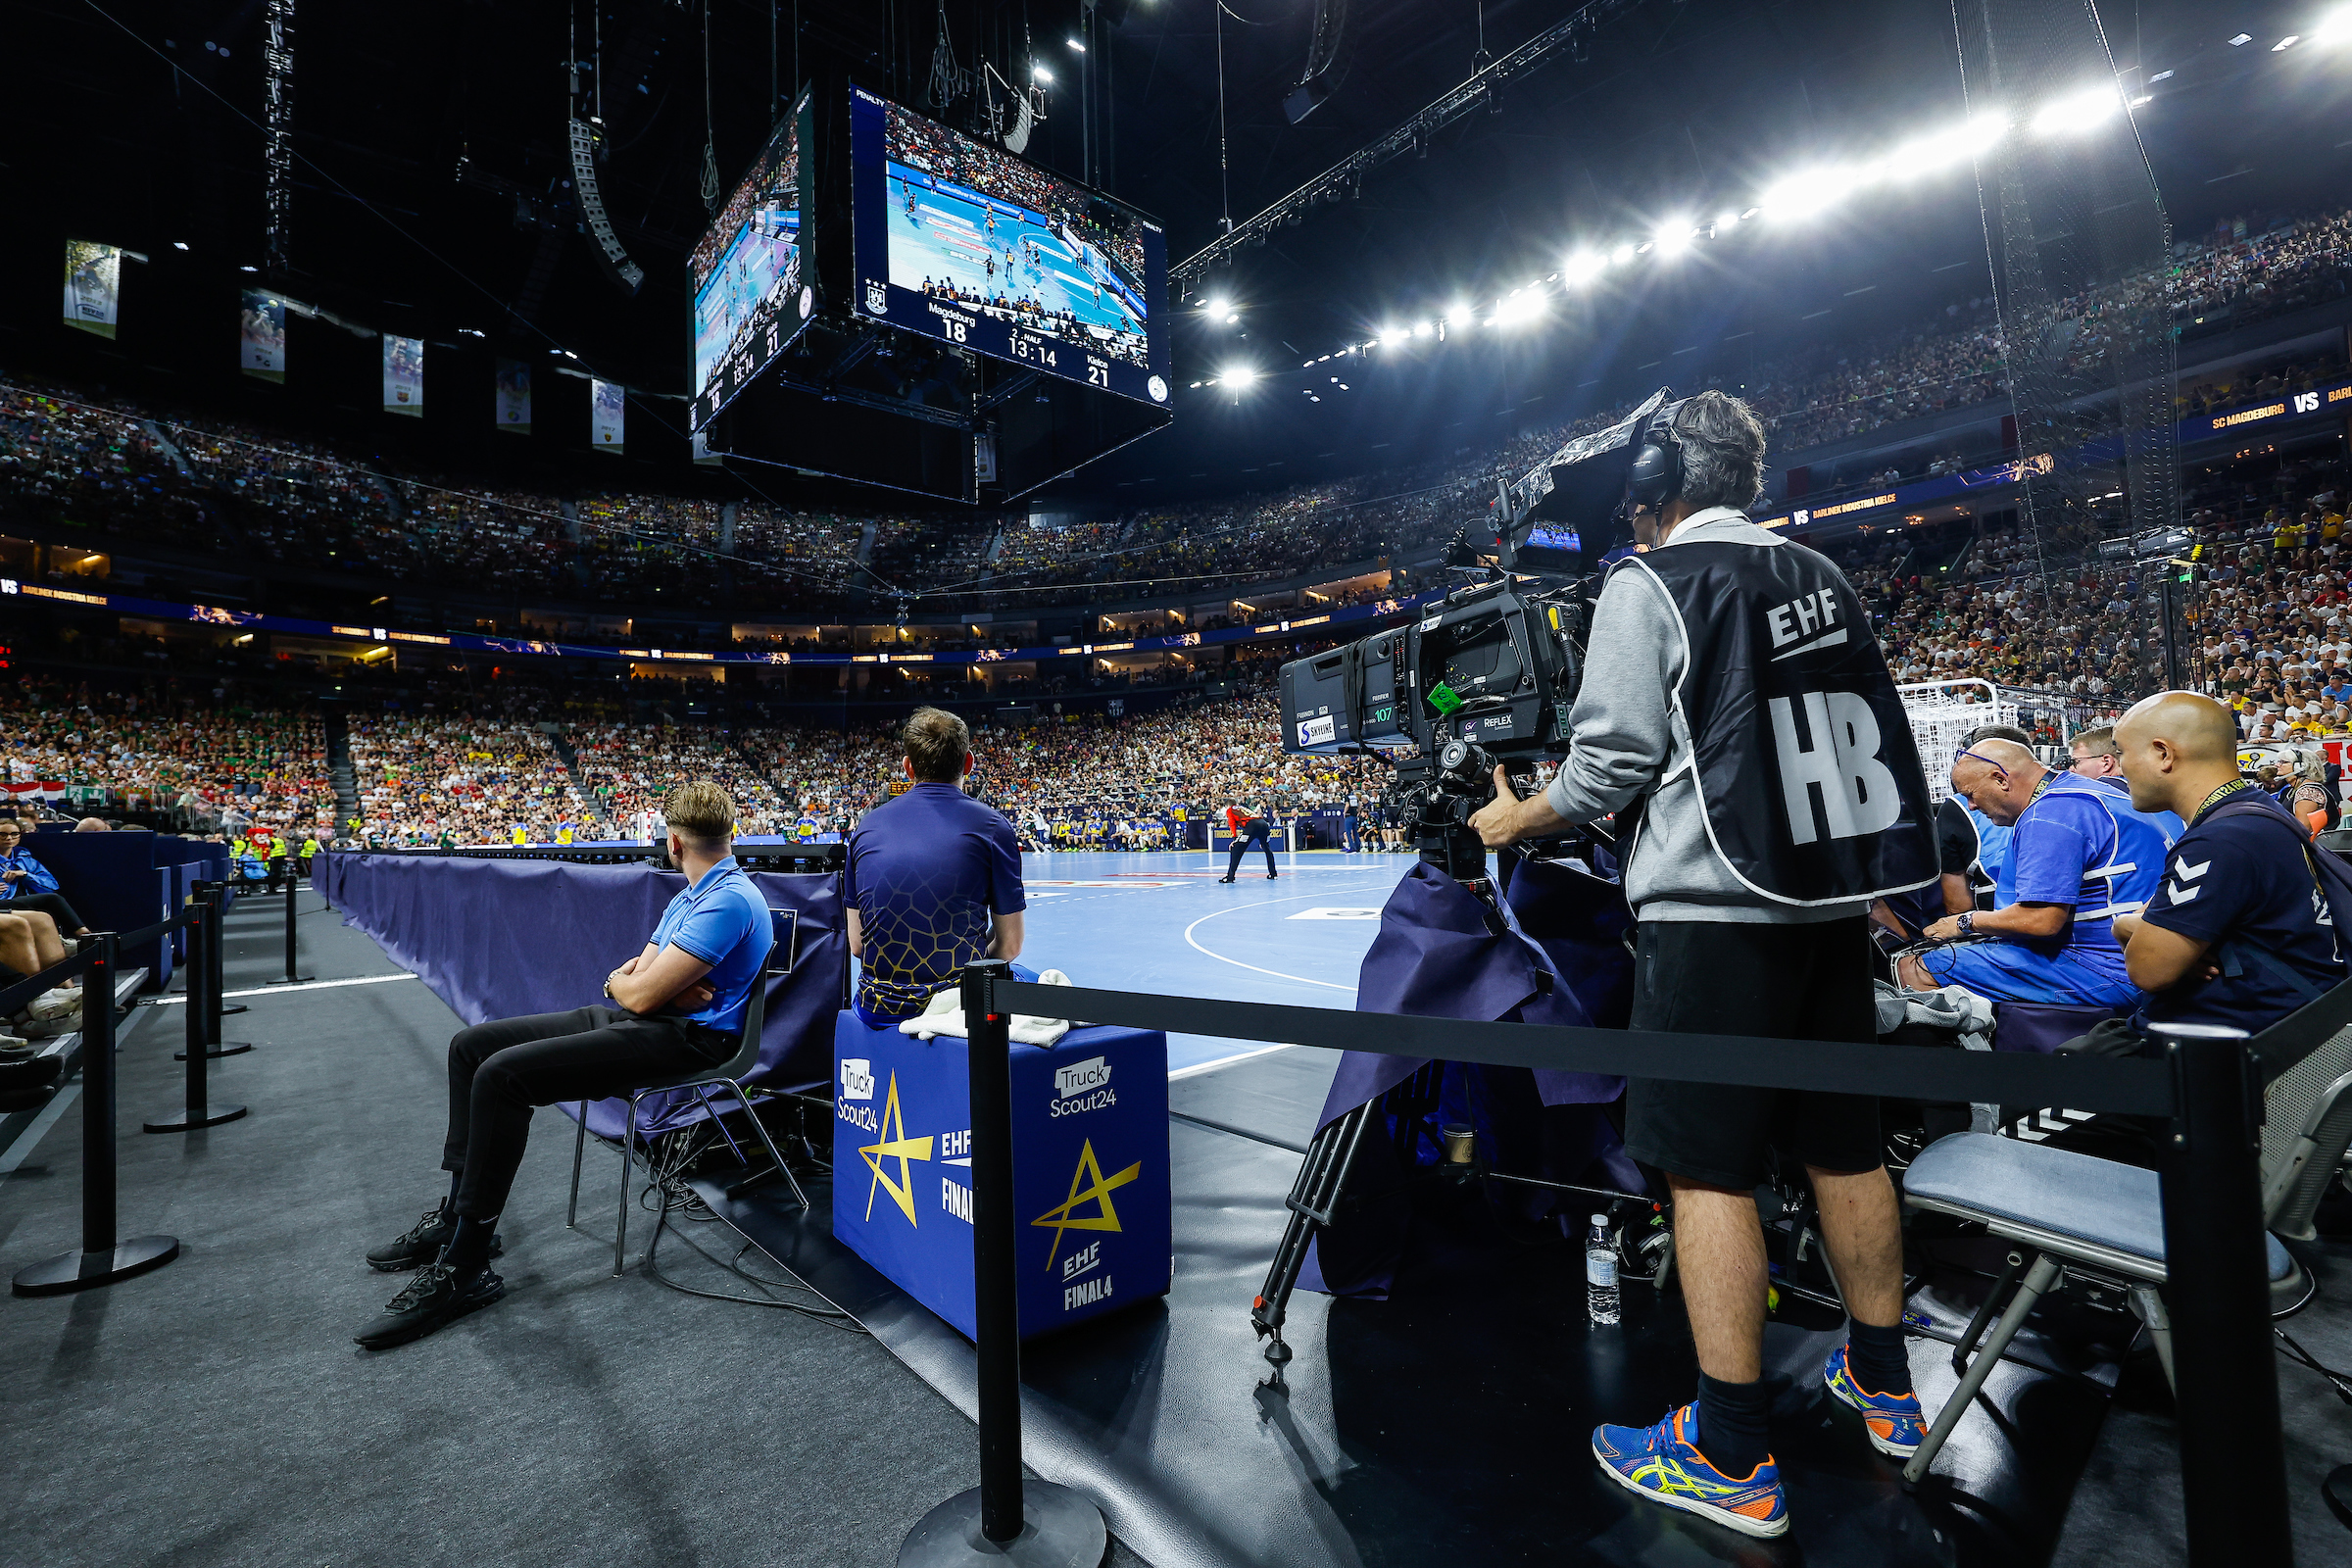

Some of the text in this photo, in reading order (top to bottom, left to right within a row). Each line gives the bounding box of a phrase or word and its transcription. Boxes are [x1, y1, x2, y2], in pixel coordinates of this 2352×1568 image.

[856, 89, 886, 108] PENALTY
[1143, 220, 1162, 234] PENALTY
[928, 302, 976, 327] Magdeburg
[943, 318, 967, 343] 18
[766, 331, 779, 358] 21
[1008, 337, 1057, 368] 13:14
[733, 354, 755, 386] 13:14
[1087, 354, 1109, 369] Kielce
[1088, 366, 1108, 388] 21
[710, 391, 720, 413] 18
[2212, 385, 2352, 429] SC MAGDEBURG VS BARL
[1792, 509, 1810, 526] VS
[1812, 504, 1842, 519] BARLINEK
[1841, 497, 1876, 514] INDUSTRIA
[1875, 493, 1897, 507] KIELCE
[0, 578, 18, 595] VS
[1766, 587, 1838, 649] EHF
[1375, 707, 1393, 722] 107
[1484, 714, 1512, 728] REFLEX
[1310, 722, 1333, 737] SKYLINE
[1768, 691, 1901, 846] HB
[844, 1064, 870, 1096] Truck
[1061, 1064, 1105, 1090] Truck
[837, 1096, 878, 1134] Scout24
[1050, 1088, 1117, 1118] Scout24
[941, 1129, 972, 1157] EHF
[942, 1176, 974, 1226] FINAL
[1063, 1241, 1101, 1277] EHF
[1064, 1275, 1113, 1311] FINAL4
